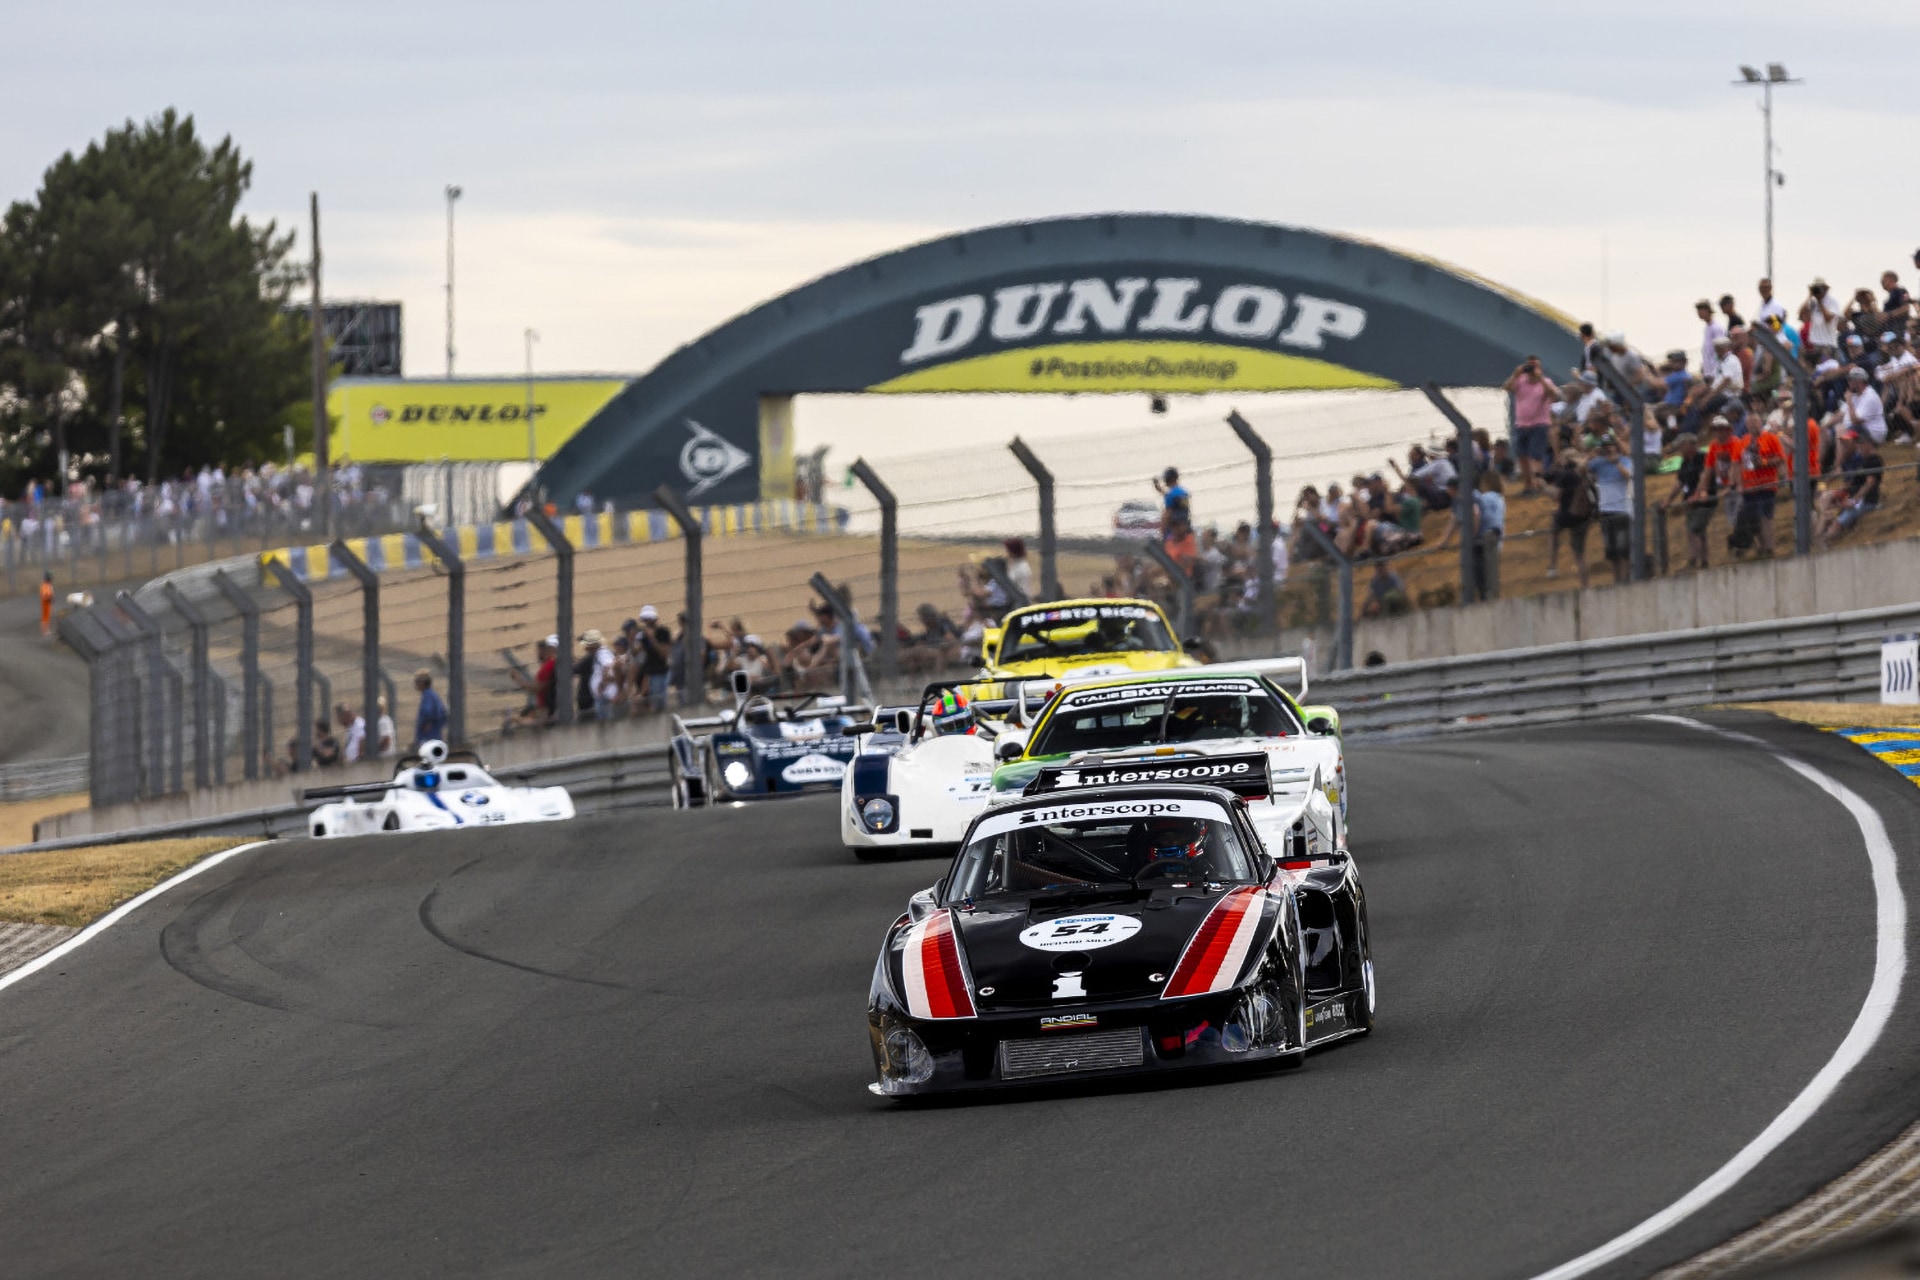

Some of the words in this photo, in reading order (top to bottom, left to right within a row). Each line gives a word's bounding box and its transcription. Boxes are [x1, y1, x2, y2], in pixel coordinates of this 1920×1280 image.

[901, 277, 1367, 364] DUNLOP
[1030, 357, 1238, 380] #PassionDunlop
[400, 404, 547, 423] DUNLOP
[1185, 683, 1249, 693] FRANCE
[1054, 762, 1250, 788] interscope
[1019, 800, 1181, 825] interscope
[1050, 922, 1111, 938] 54
[1040, 1013, 1098, 1025] ANDIAL
